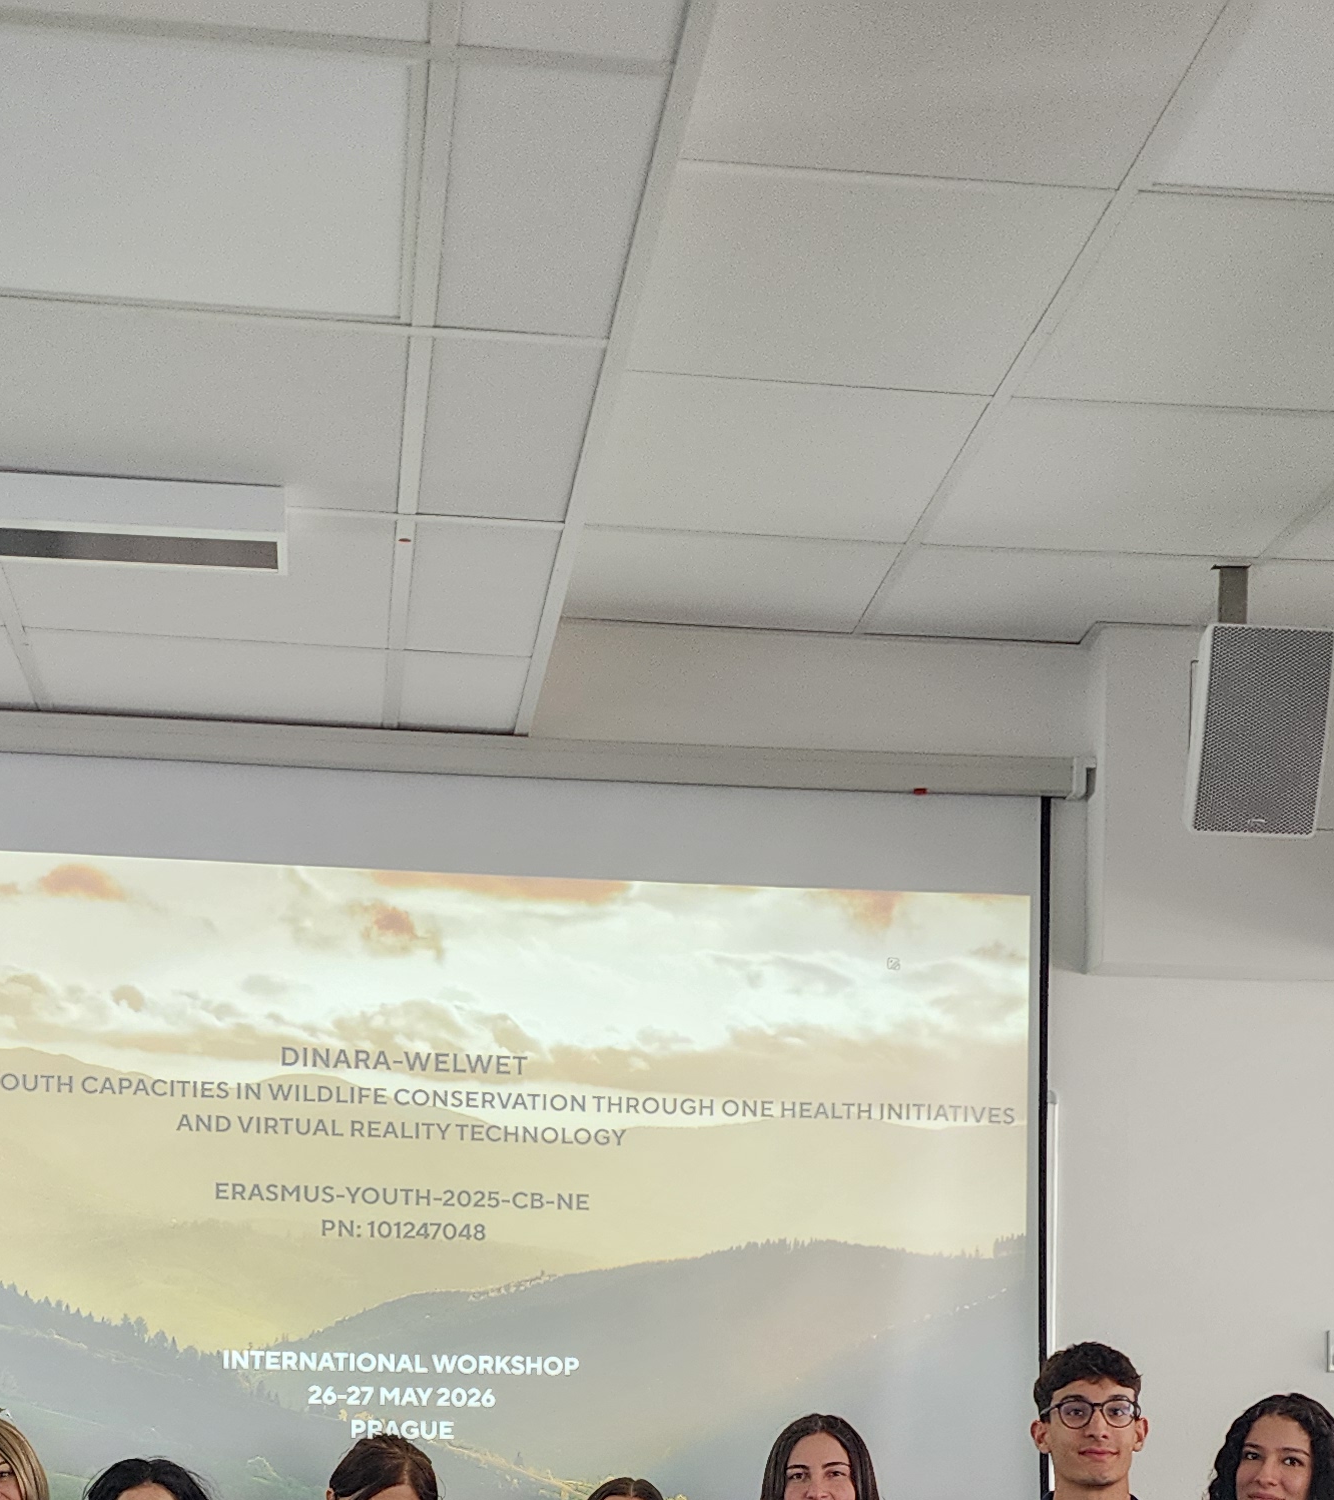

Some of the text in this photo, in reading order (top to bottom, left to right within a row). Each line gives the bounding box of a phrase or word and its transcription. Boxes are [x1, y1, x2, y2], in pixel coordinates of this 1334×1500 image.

[281, 1047, 528, 1076] DINARA-WELWET
[81, 1075, 230, 1100] CAPACITIES
[236, 1081, 263, 1101] IN
[268, 1083, 387, 1106] WILDLIFE
[393, 1087, 587, 1114] CONSERVATION
[592, 1095, 714, 1117] THROUGH
[721, 1099, 774, 1119] ONE
[780, 1101, 873, 1121] HEALTH
[879, 1102, 1016, 1126] INITIATIVES
[176, 1114, 627, 1147] AND VIRTUAL REALITY TECHNOLOGY
[215, 1182, 590, 1211] ERASMUS-YOUTH-2025-CB-NE
[320, 1219, 486, 1242] PN: 101247048
[222, 1350, 580, 1377] INTERNATIONAL WORKSHOP
[307, 1386, 496, 1409] 26-27 MAY 2026
[351, 1419, 455, 1441] PRAGUE
